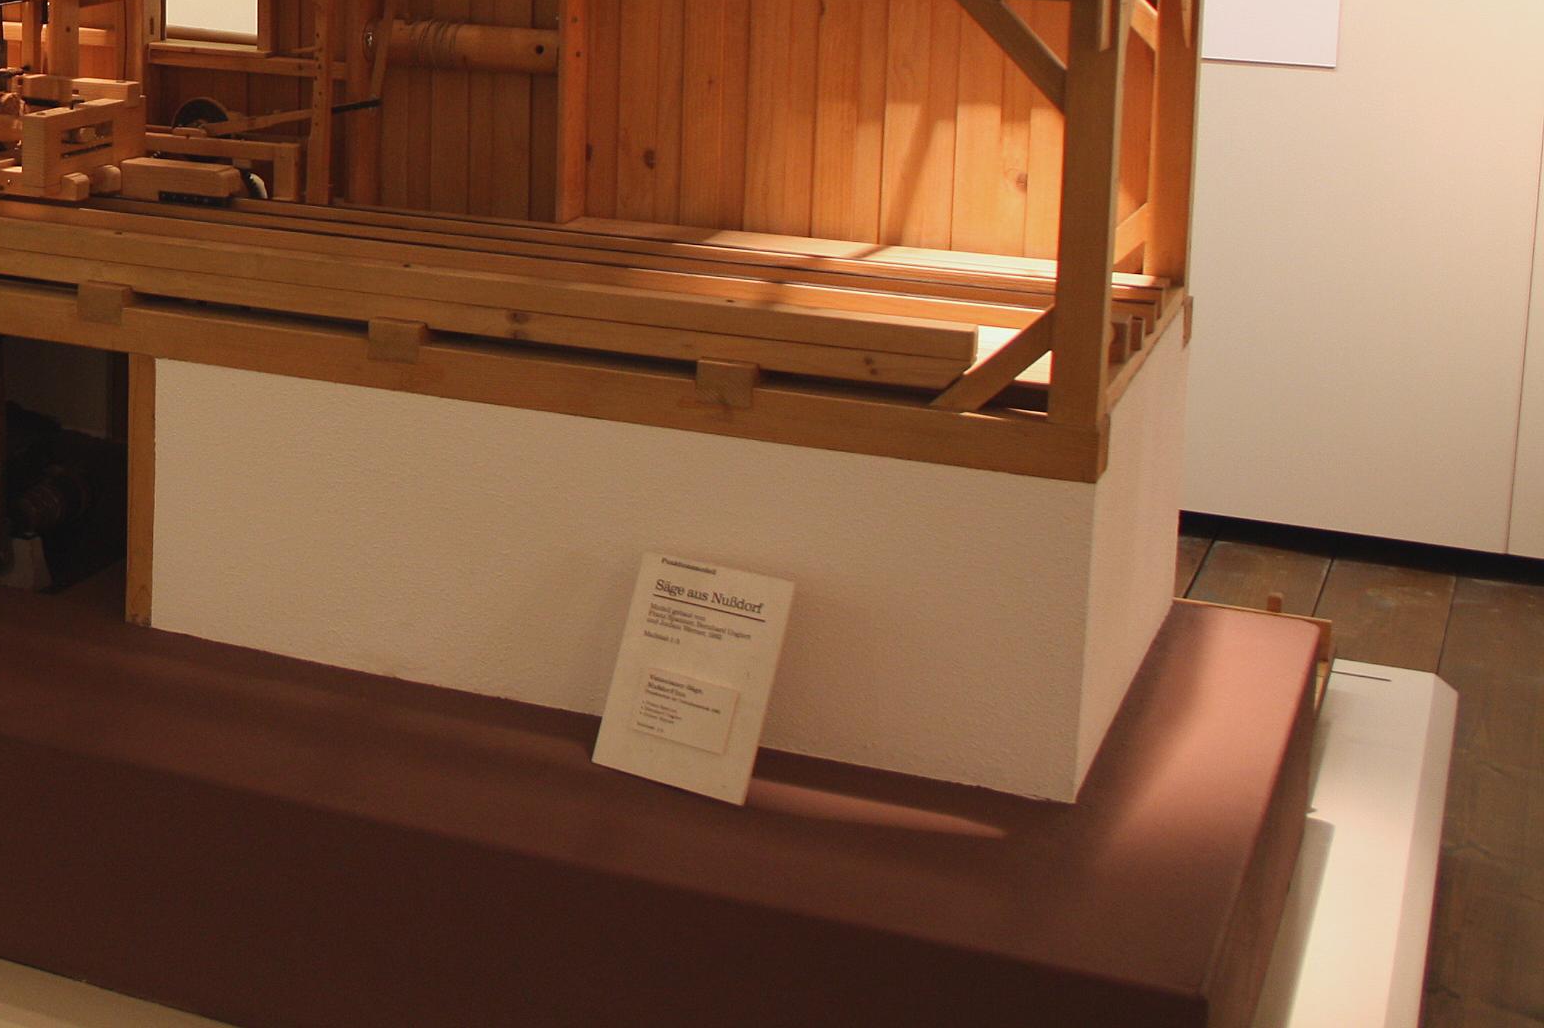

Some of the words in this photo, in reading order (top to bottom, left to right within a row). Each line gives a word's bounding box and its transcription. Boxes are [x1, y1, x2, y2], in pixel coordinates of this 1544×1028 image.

[656, 579, 684, 597] Säge
[687, 588, 709, 602] aus
[711, 592, 764, 613] Nußdorf
